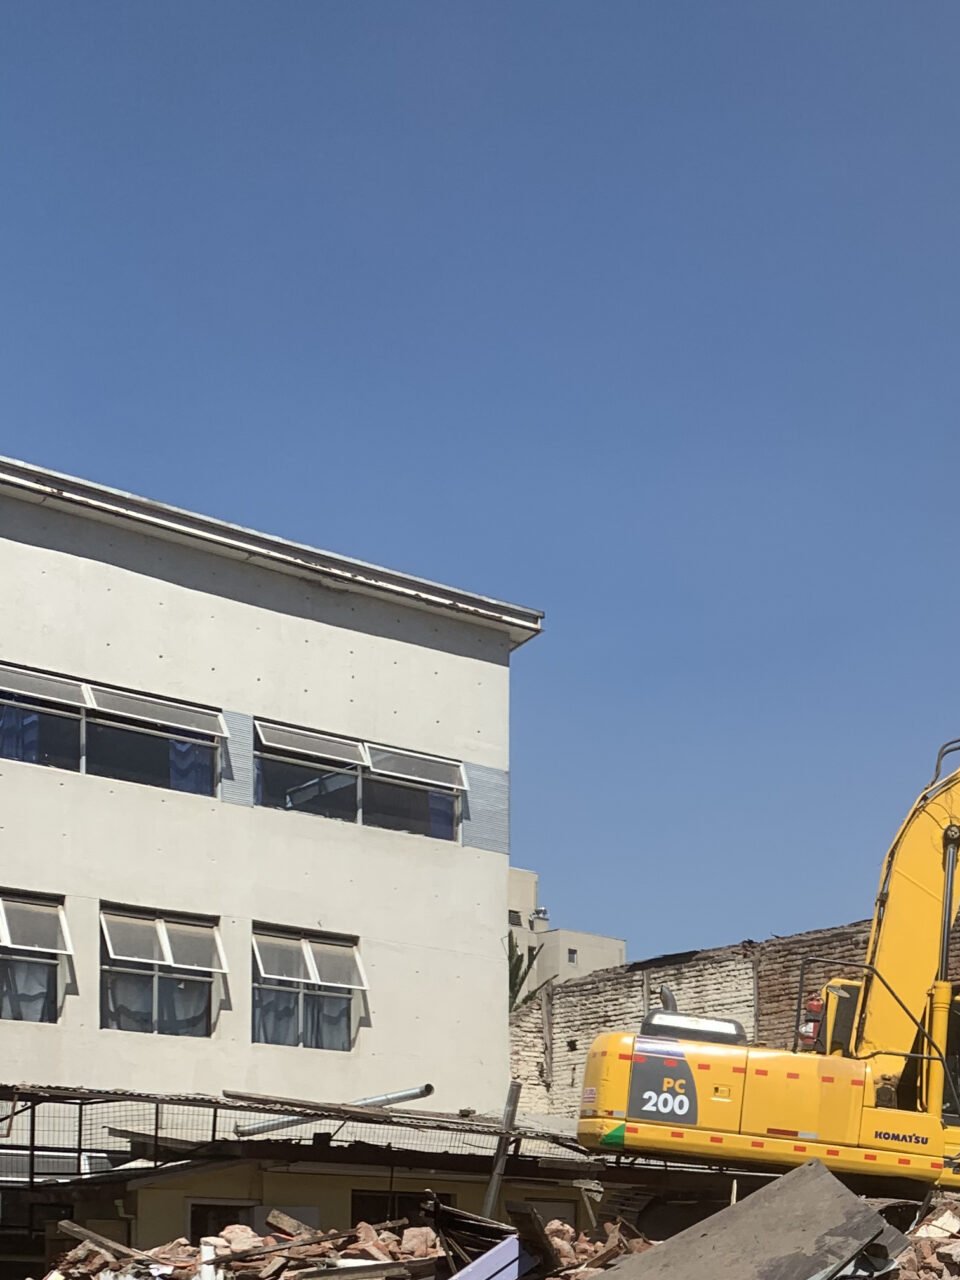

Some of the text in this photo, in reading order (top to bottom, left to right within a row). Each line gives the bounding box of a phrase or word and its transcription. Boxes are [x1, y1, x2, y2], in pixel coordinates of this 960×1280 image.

[662, 1077, 686, 1094] PC
[641, 1091, 690, 1116] 200
[874, 1130, 929, 1145] KOMATSU
